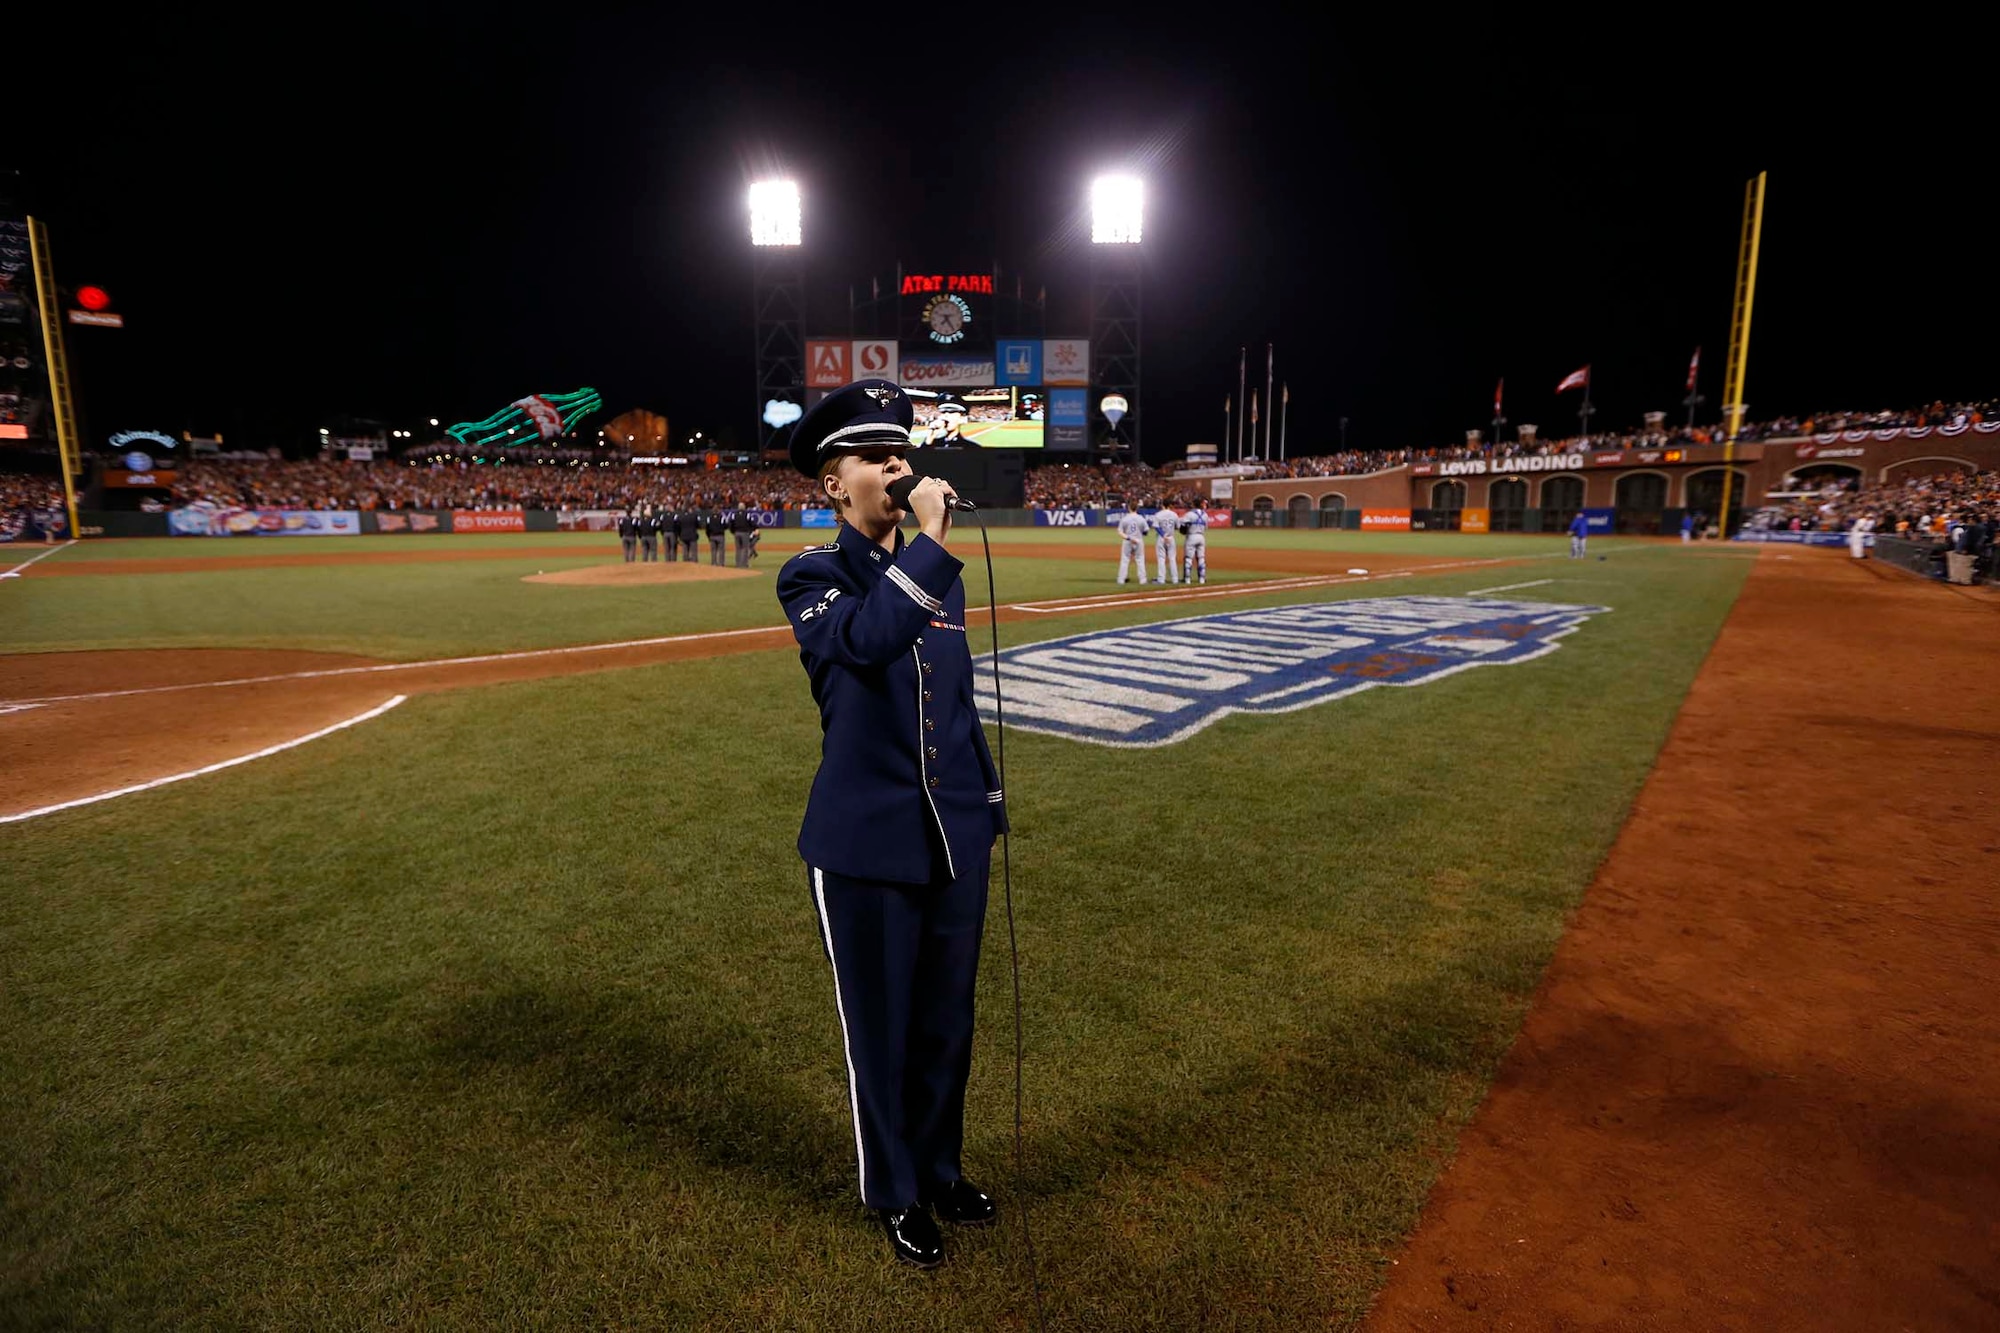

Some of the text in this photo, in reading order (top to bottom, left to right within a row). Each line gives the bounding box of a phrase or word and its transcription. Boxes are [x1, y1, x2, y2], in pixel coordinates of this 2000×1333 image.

[901, 275, 993, 295] AT&T PARK
[930, 331, 965, 344] GIANTS
[903, 360, 954, 382] Coors
[1491, 454, 1584, 473] LANDING
[475, 513, 524, 526] TOYOTA
[1044, 510, 1086, 526] VISA
